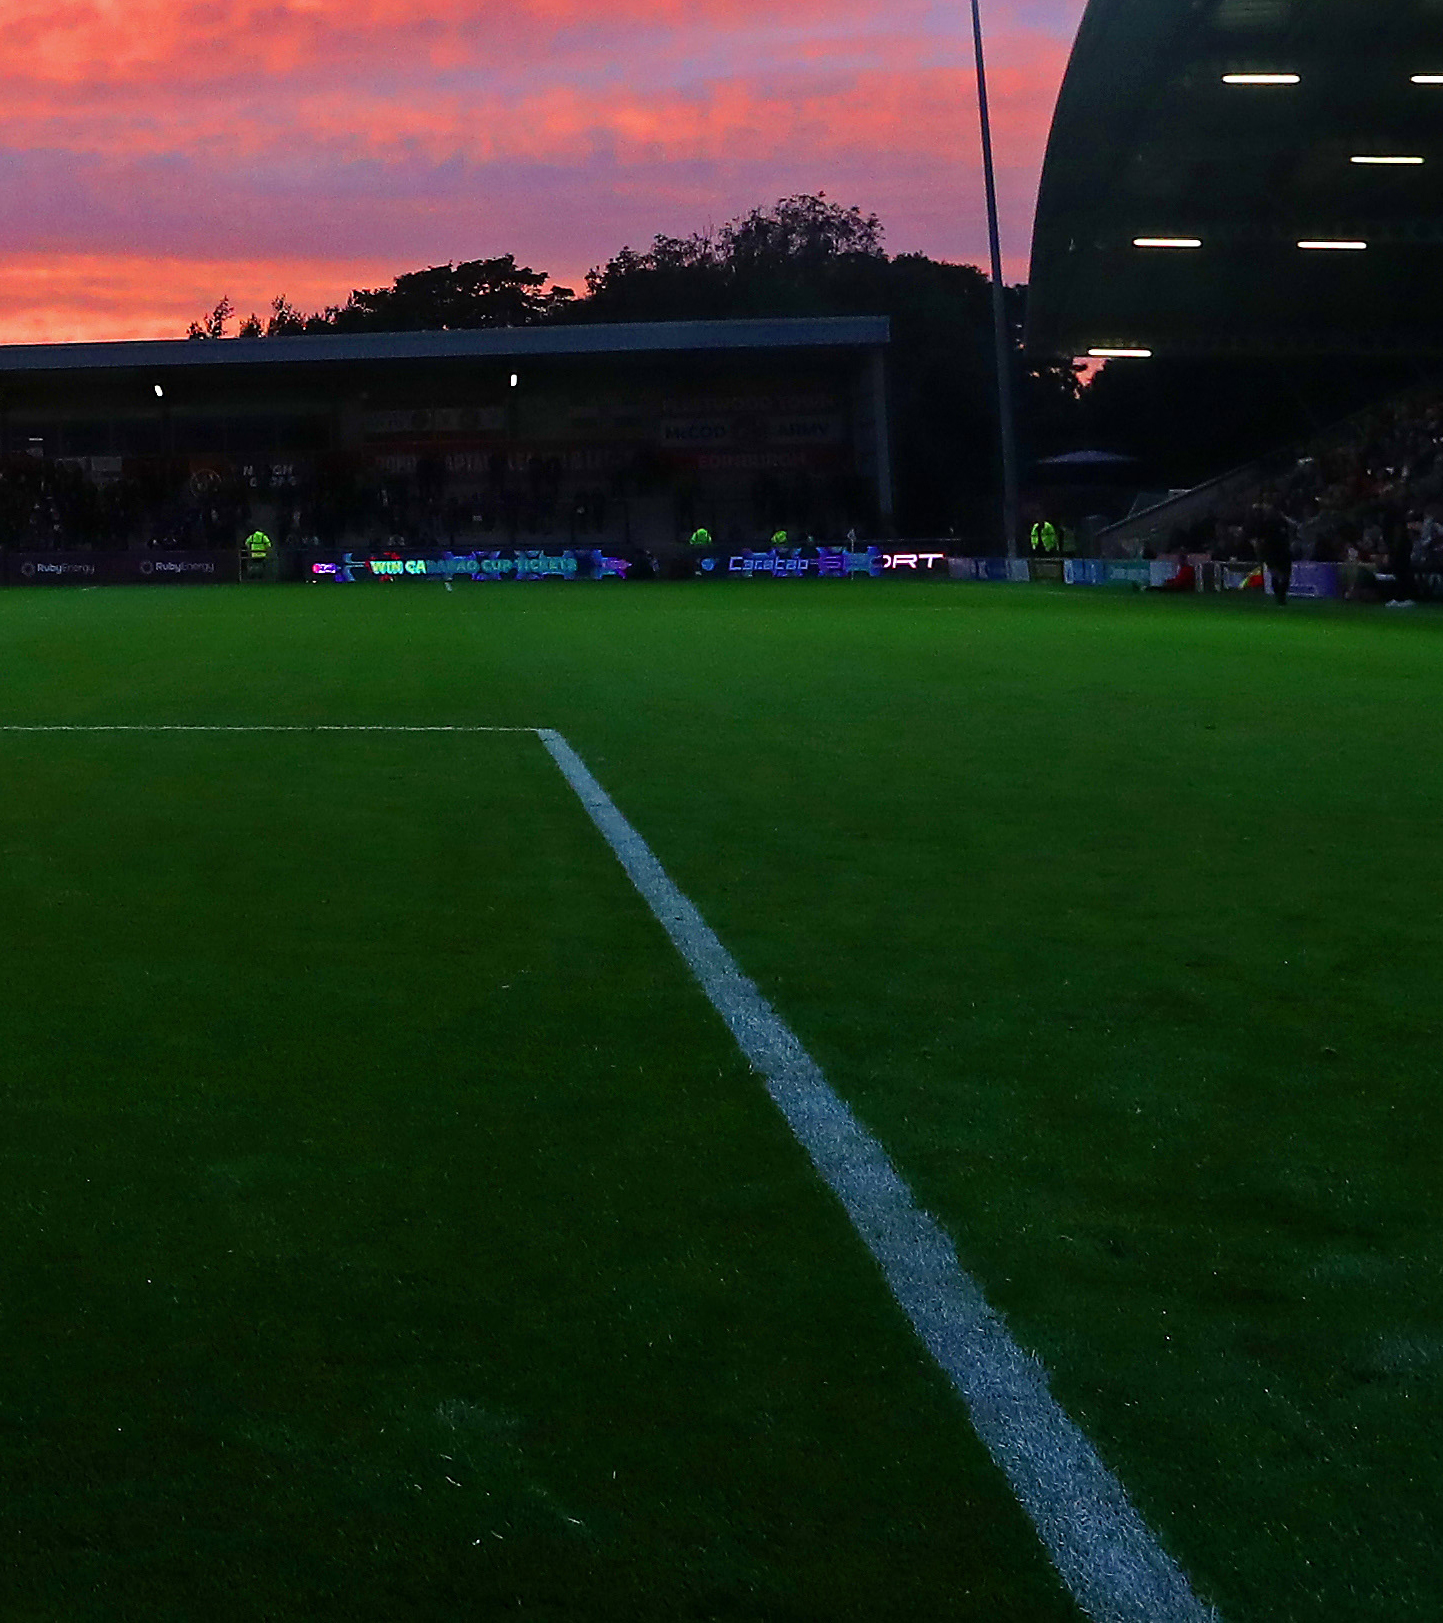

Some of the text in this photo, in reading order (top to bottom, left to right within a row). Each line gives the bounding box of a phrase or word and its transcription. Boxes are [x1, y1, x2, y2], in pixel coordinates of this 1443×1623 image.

[370, 559, 404, 575] WIN
[481, 558, 513, 574] CUP
[514, 557, 578, 574] TICKETS
[729, 556, 809, 571] Carabao
